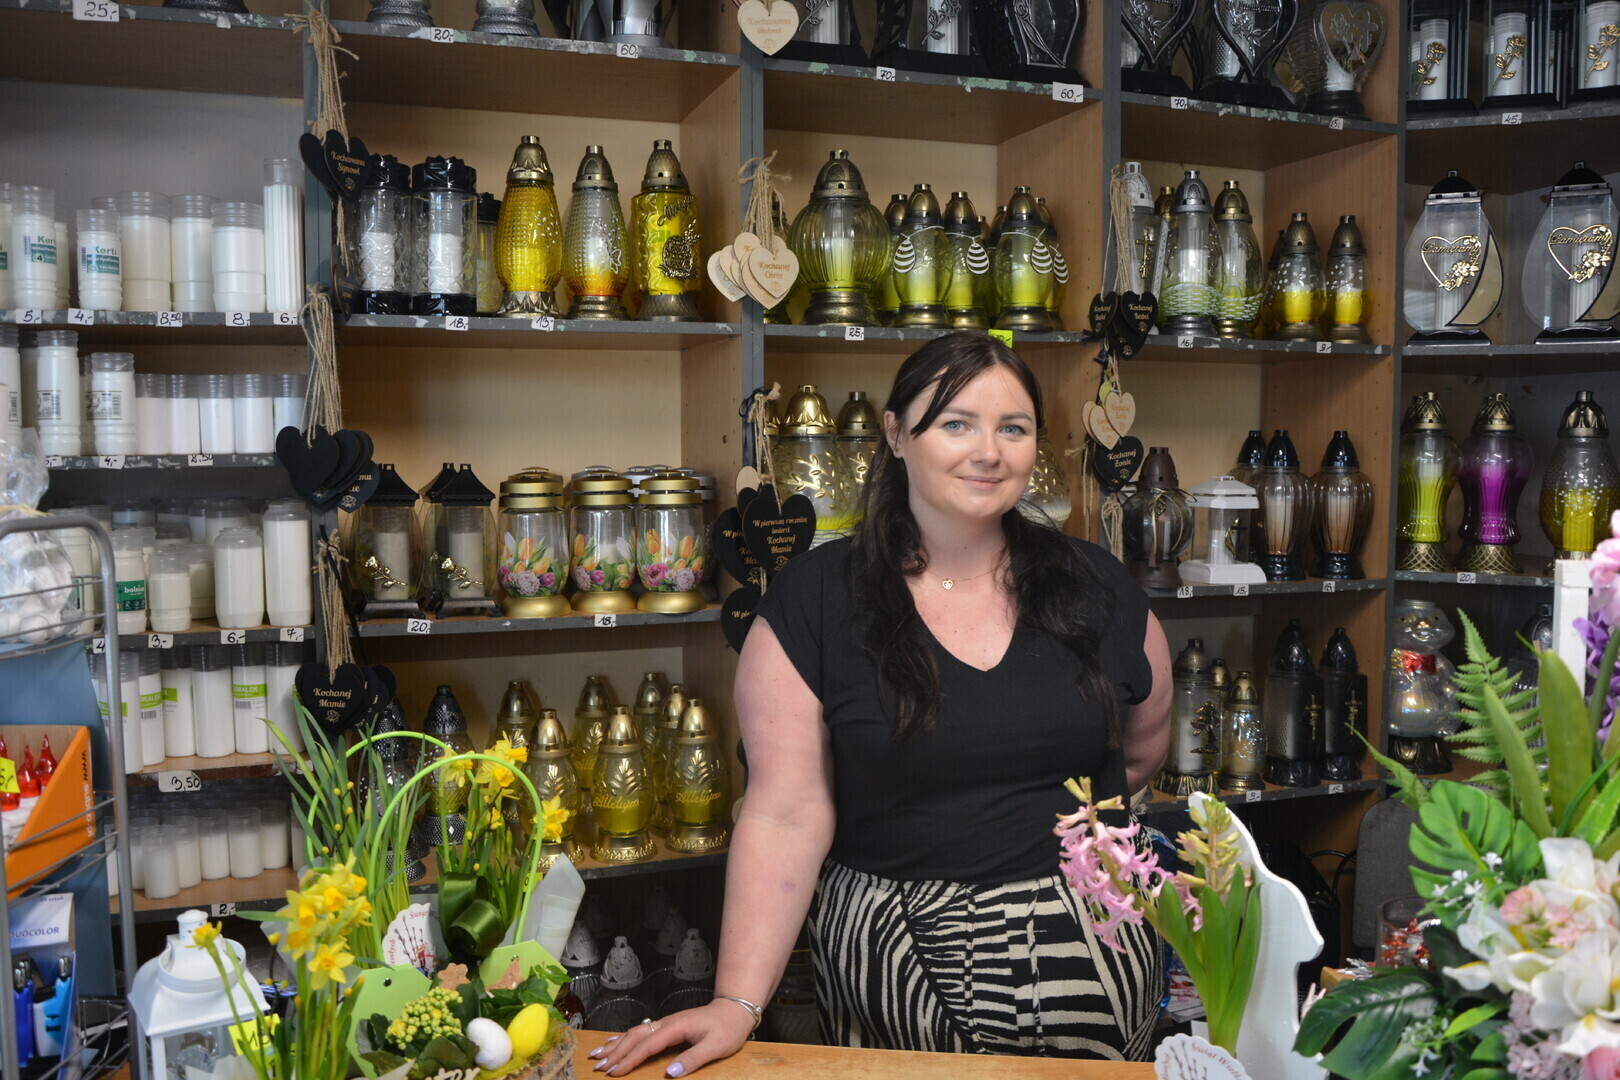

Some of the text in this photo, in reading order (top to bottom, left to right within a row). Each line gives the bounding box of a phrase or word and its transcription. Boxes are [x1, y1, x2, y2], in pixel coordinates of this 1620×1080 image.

[313, 687, 352, 699] Kochanej
[319, 699, 347, 708] Mamie
[171, 776, 200, 791] 3,50
